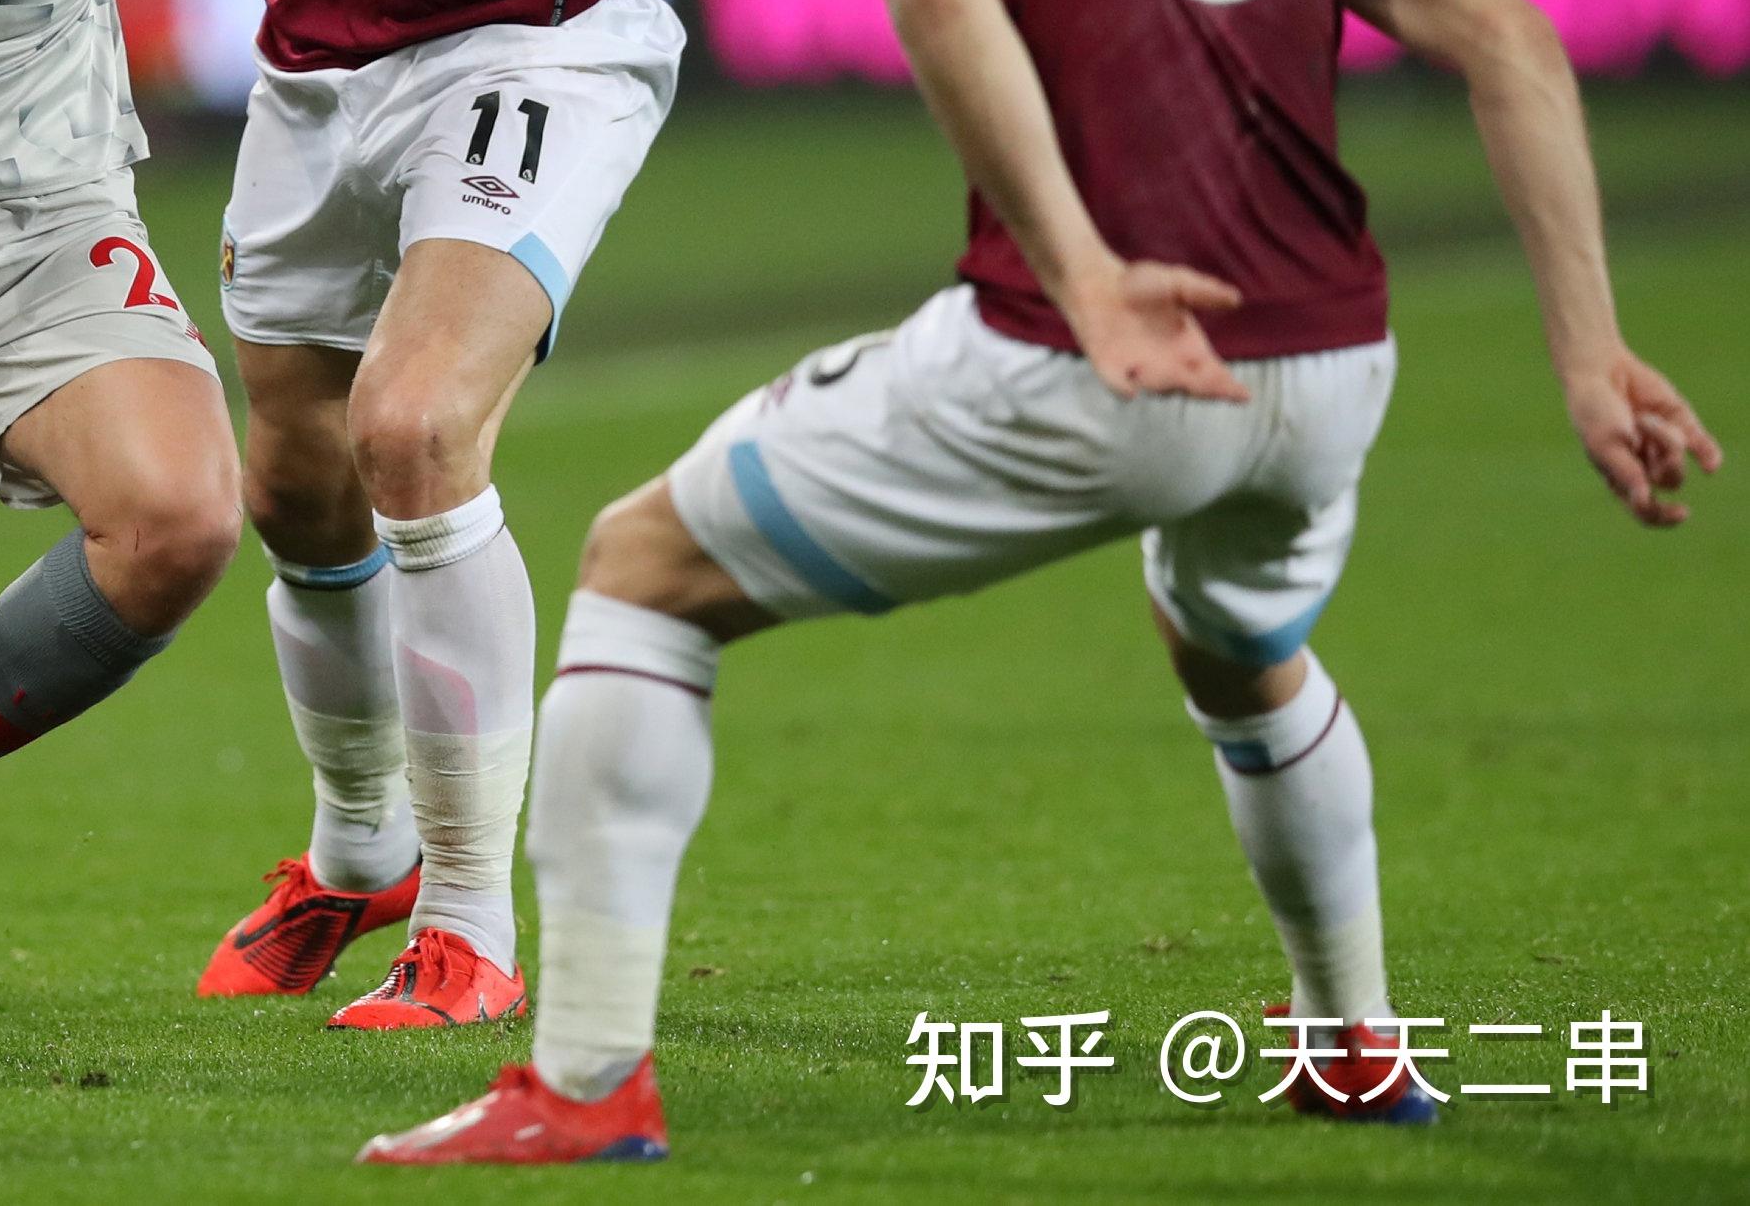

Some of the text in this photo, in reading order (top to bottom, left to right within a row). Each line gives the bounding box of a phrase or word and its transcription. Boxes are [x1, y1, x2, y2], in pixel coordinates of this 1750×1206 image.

[464, 90, 550, 185] 11
[461, 194, 511, 215] umbro
[88, 236, 180, 312] 2
